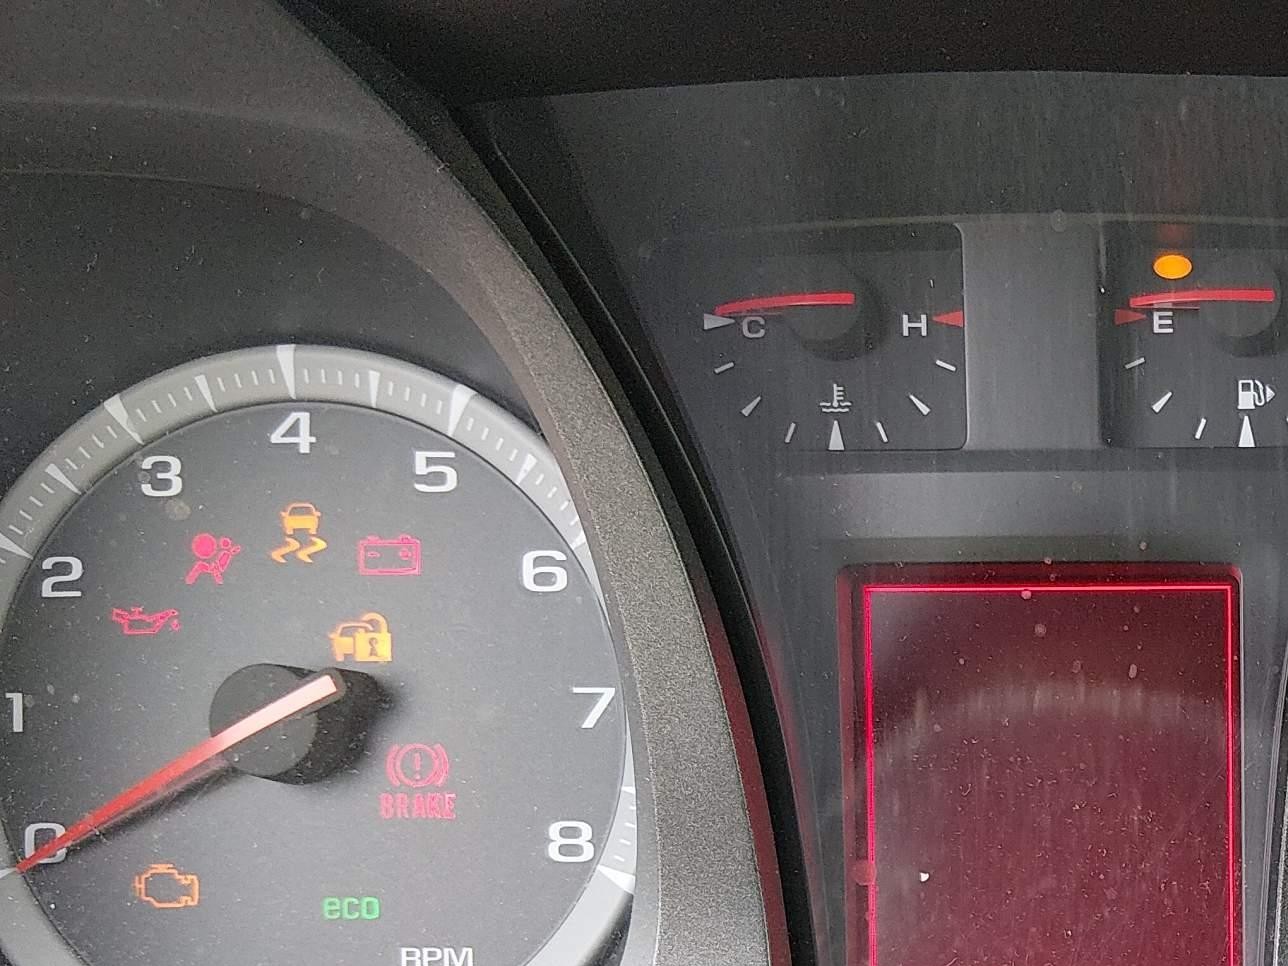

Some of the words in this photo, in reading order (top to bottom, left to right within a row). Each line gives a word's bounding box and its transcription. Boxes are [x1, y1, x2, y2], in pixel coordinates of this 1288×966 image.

[741, 317, 765, 338] C
[902, 314, 927, 336] H
[1154, 311, 1173, 333] E
[271, 412, 315, 453] 4
[141, 456, 182, 497] 3
[414, 451, 458, 492] 5
[41, 556, 82, 597] 2
[522, 551, 568, 592] 6
[4, 693, 24, 732] 1
[572, 687, 617, 729] 7
[380, 793, 457, 820] BRAKE
[23, 822, 67, 863] 0
[547, 821, 594, 862] 8
[322, 896, 380, 921] eco
